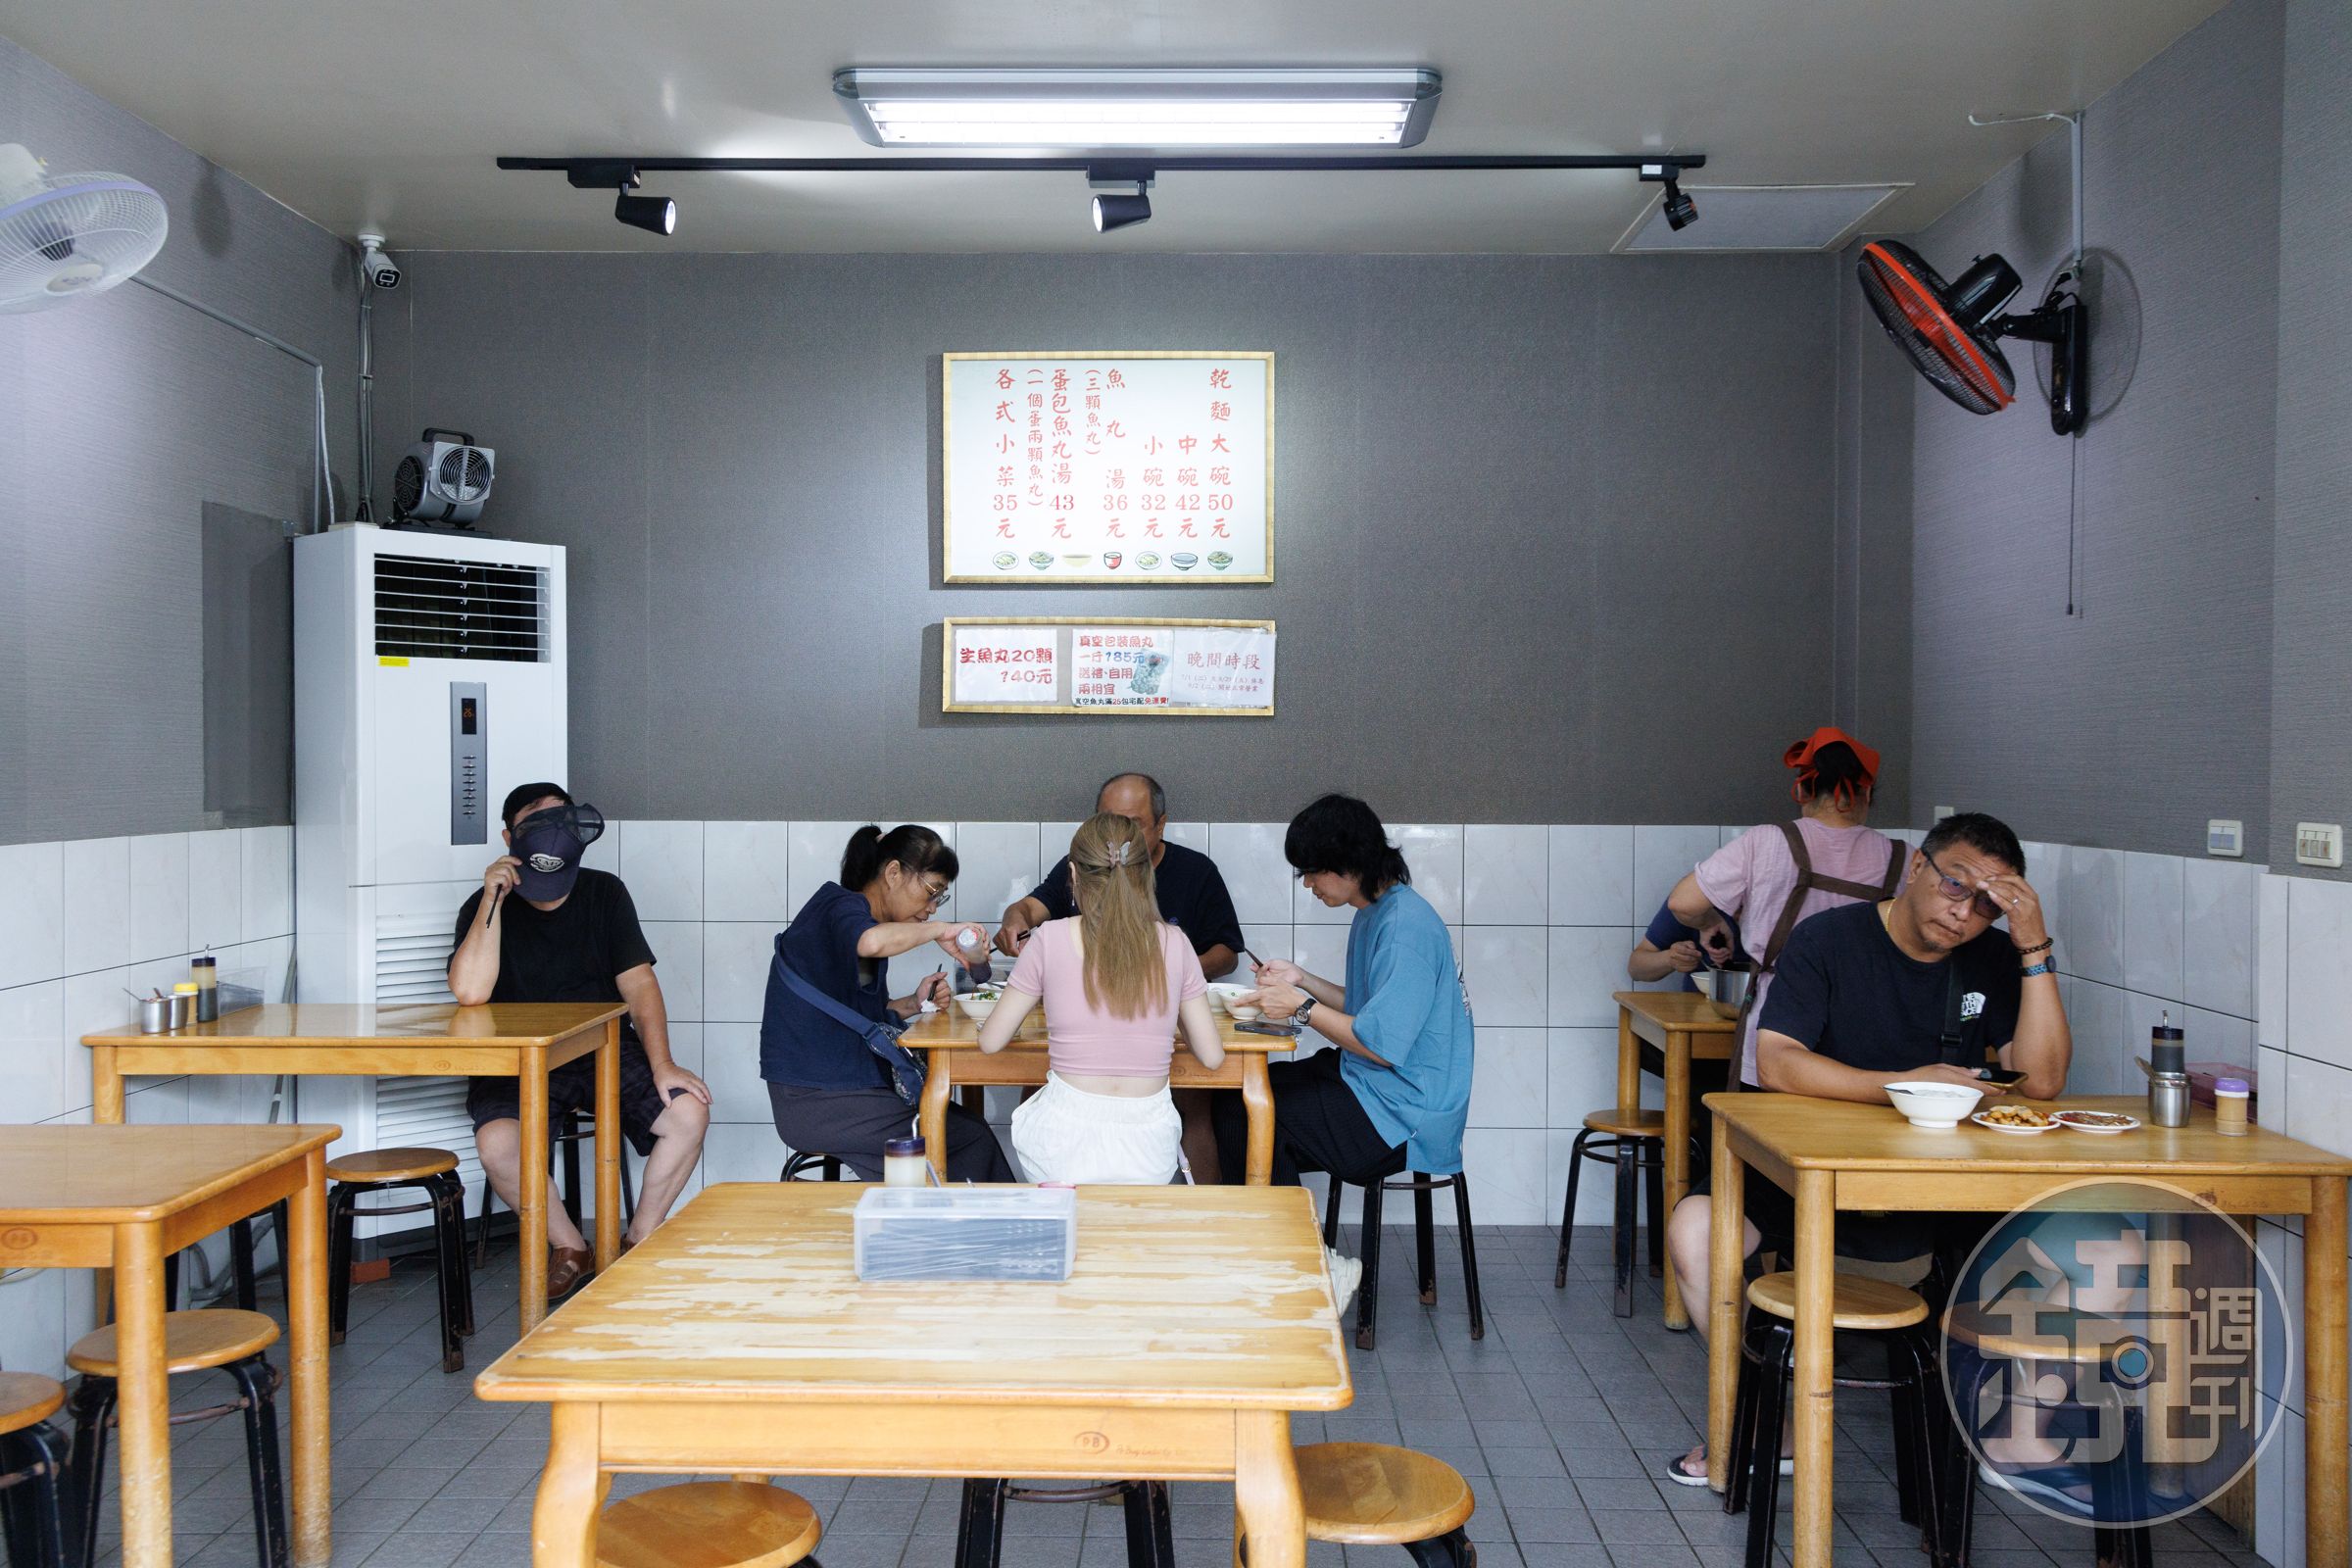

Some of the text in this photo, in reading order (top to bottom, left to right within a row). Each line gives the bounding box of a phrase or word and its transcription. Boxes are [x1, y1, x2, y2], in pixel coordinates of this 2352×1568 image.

[1079, 635, 1153, 648] 真空包裝魚丸
[959, 647, 1053, 664] 生魚丸20顆
[1187, 651, 1261, 669] 晚間時段
[1078, 683, 1115, 695] 兩相宜
